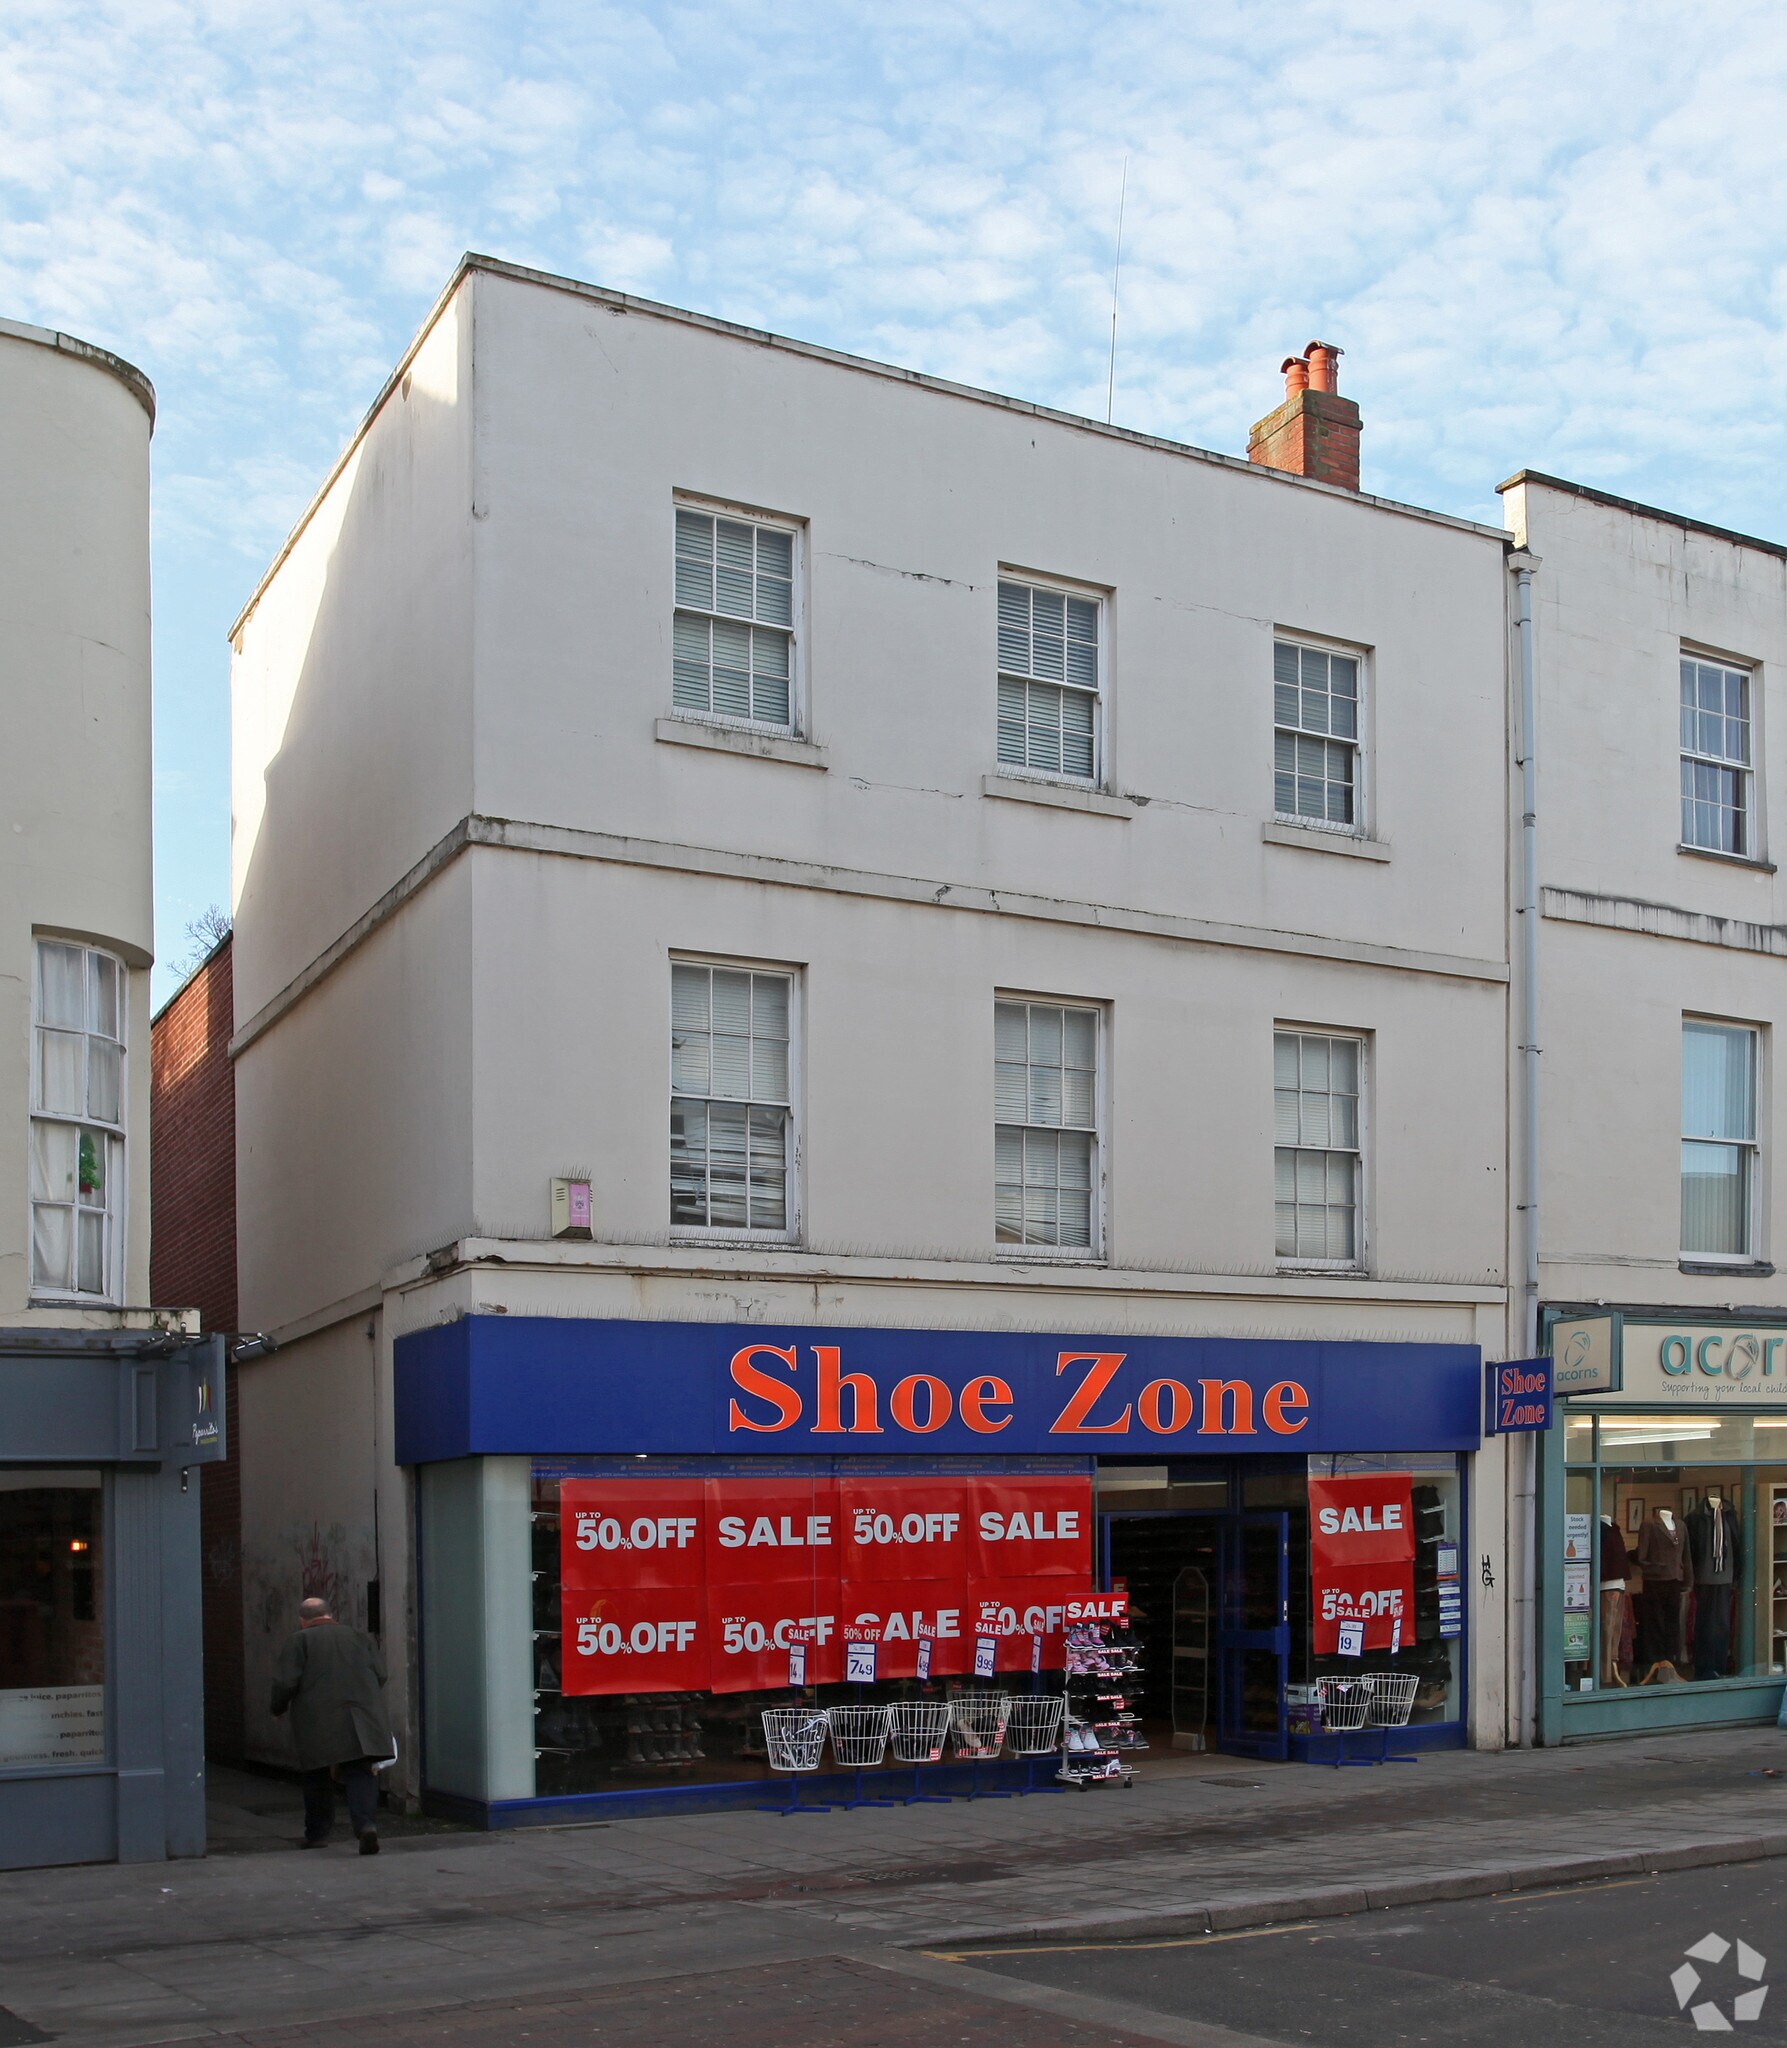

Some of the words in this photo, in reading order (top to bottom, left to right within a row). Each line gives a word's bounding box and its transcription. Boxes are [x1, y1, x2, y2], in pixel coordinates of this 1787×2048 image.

[1501, 1368, 1546, 1395] Shoe
[1557, 1368, 1598, 1381] acorns
[729, 1344, 1013, 1432] Shoe
[1048, 1352, 1309, 1435] Zone
[1661, 1381, 1709, 1400] Supporting
[1715, 1385, 1736, 1401] your
[1740, 1382, 1761, 1393] local
[1501, 1399, 1545, 1426] Zone
[979, 1511, 1080, 1541] SALE
[1319, 1504, 1403, 1534] SALE
[718, 1516, 832, 1548] SALE
[1067, 1601, 1126, 1618] SALE
[1336, 1606, 1371, 1618] SALE
[788, 1628, 810, 1640] SALE
[844, 1628, 862, 1640] 50%
[864, 1628, 881, 1640] OFF
[919, 1623, 936, 1637] SALE
[975, 1622, 1002, 1635] SALE
